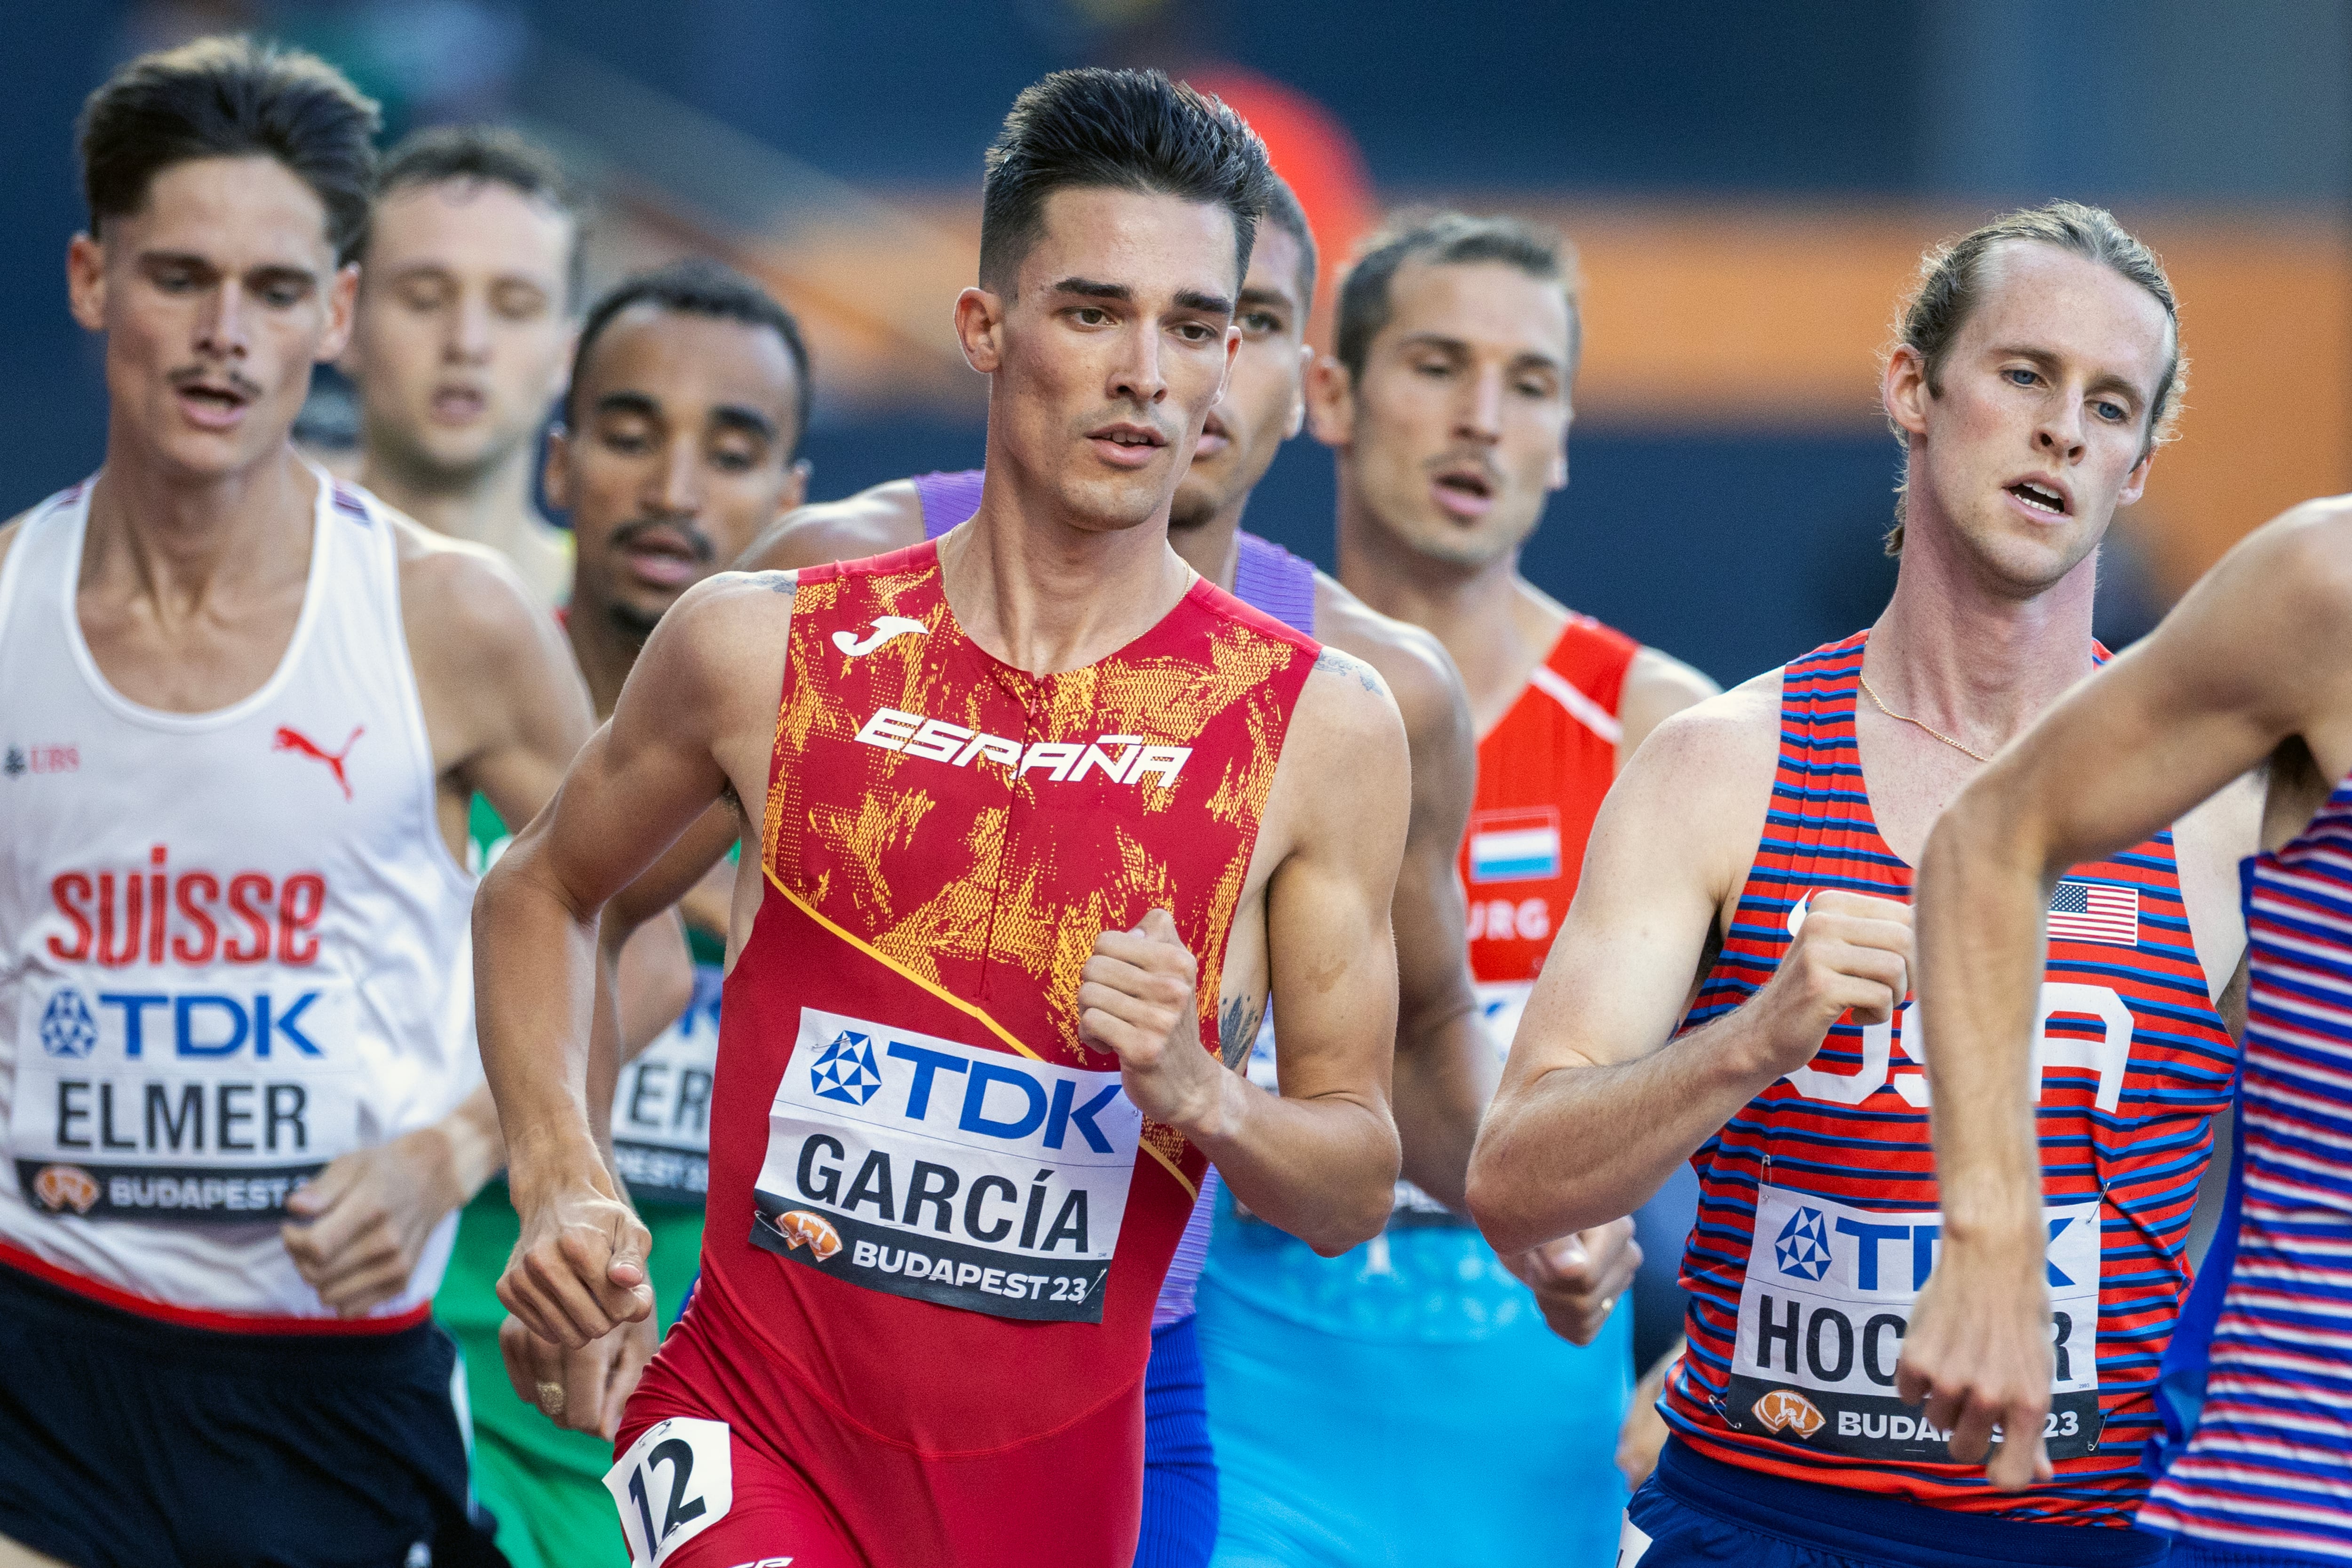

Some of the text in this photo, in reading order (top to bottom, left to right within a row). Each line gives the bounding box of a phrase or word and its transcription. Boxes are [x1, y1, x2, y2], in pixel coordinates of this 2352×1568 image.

[854, 707, 1193, 788] ESPAÑA
[99, 989, 326, 1060] TDK
[56, 1081, 307, 1152] ELMER
[887, 1041, 1122, 1154] TDK
[796, 1134, 1089, 1253] GARCÍA
[852, 1241, 1088, 1303] BUDAPEST 23
[1756, 1294, 2074, 1386] HOCR
[628, 1438, 707, 1564] 12
